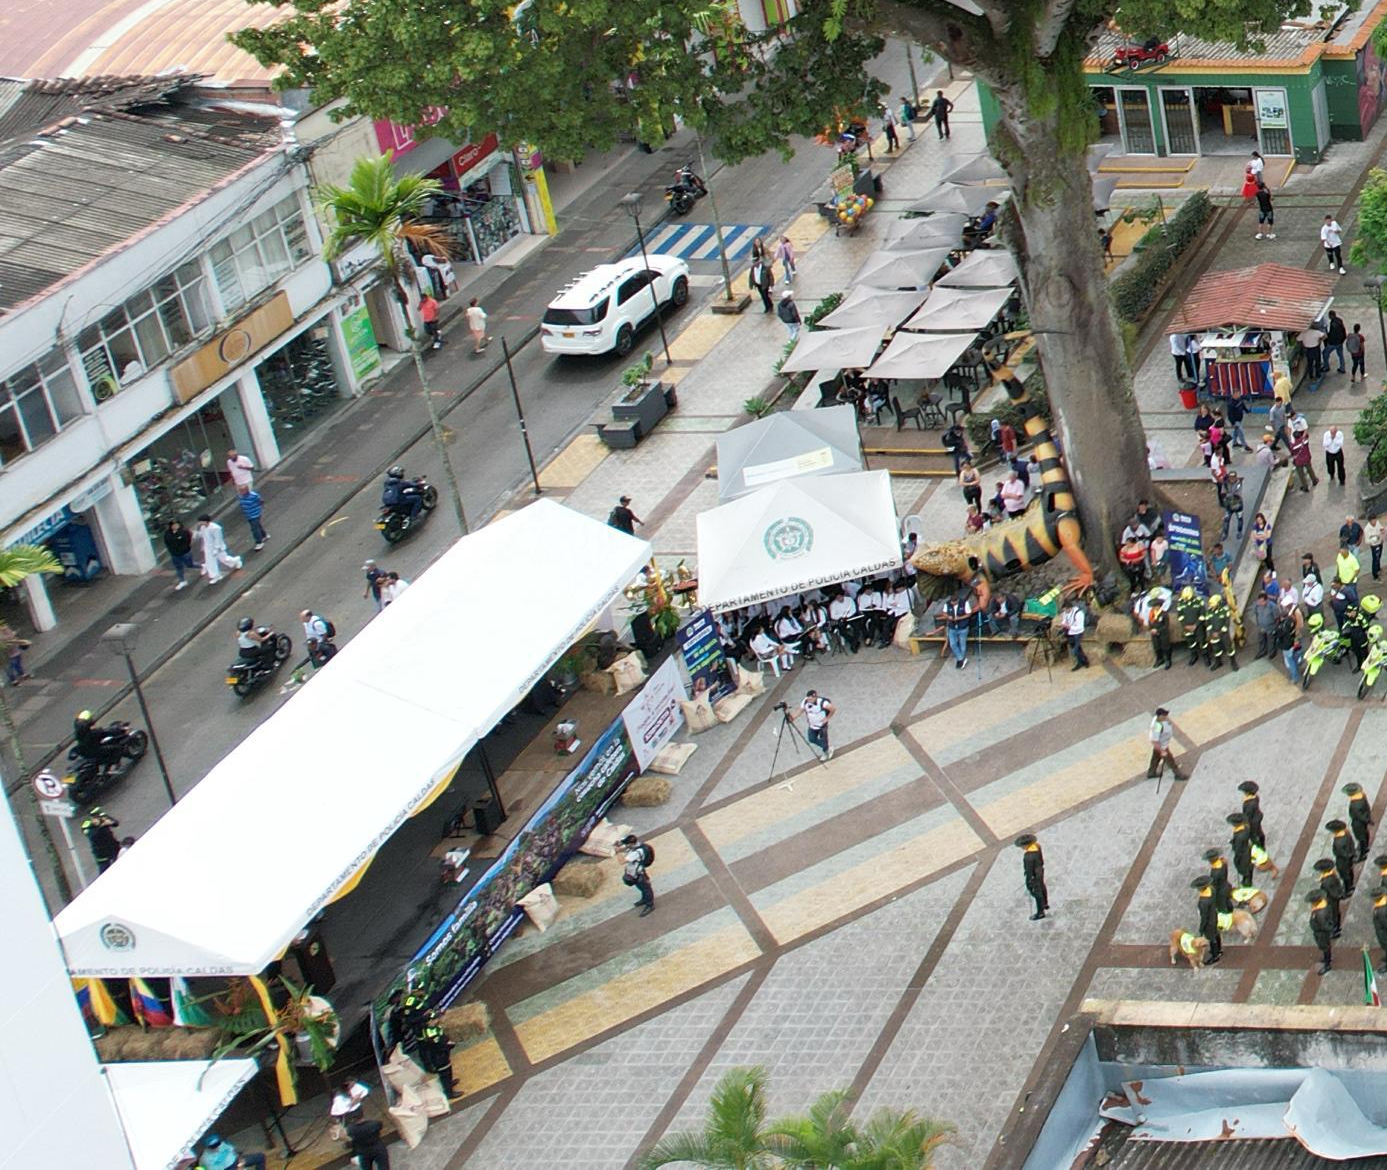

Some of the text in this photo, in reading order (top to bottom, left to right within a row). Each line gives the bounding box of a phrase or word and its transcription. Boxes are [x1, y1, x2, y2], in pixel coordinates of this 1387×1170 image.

[701, 585, 788, 611] DEPARTAMENTO
[790, 581, 806, 592] DE
[852, 558, 896, 577] CALDAS
[425, 931, 453, 967] Somos
[186, 965, 235, 975] CALDAS
